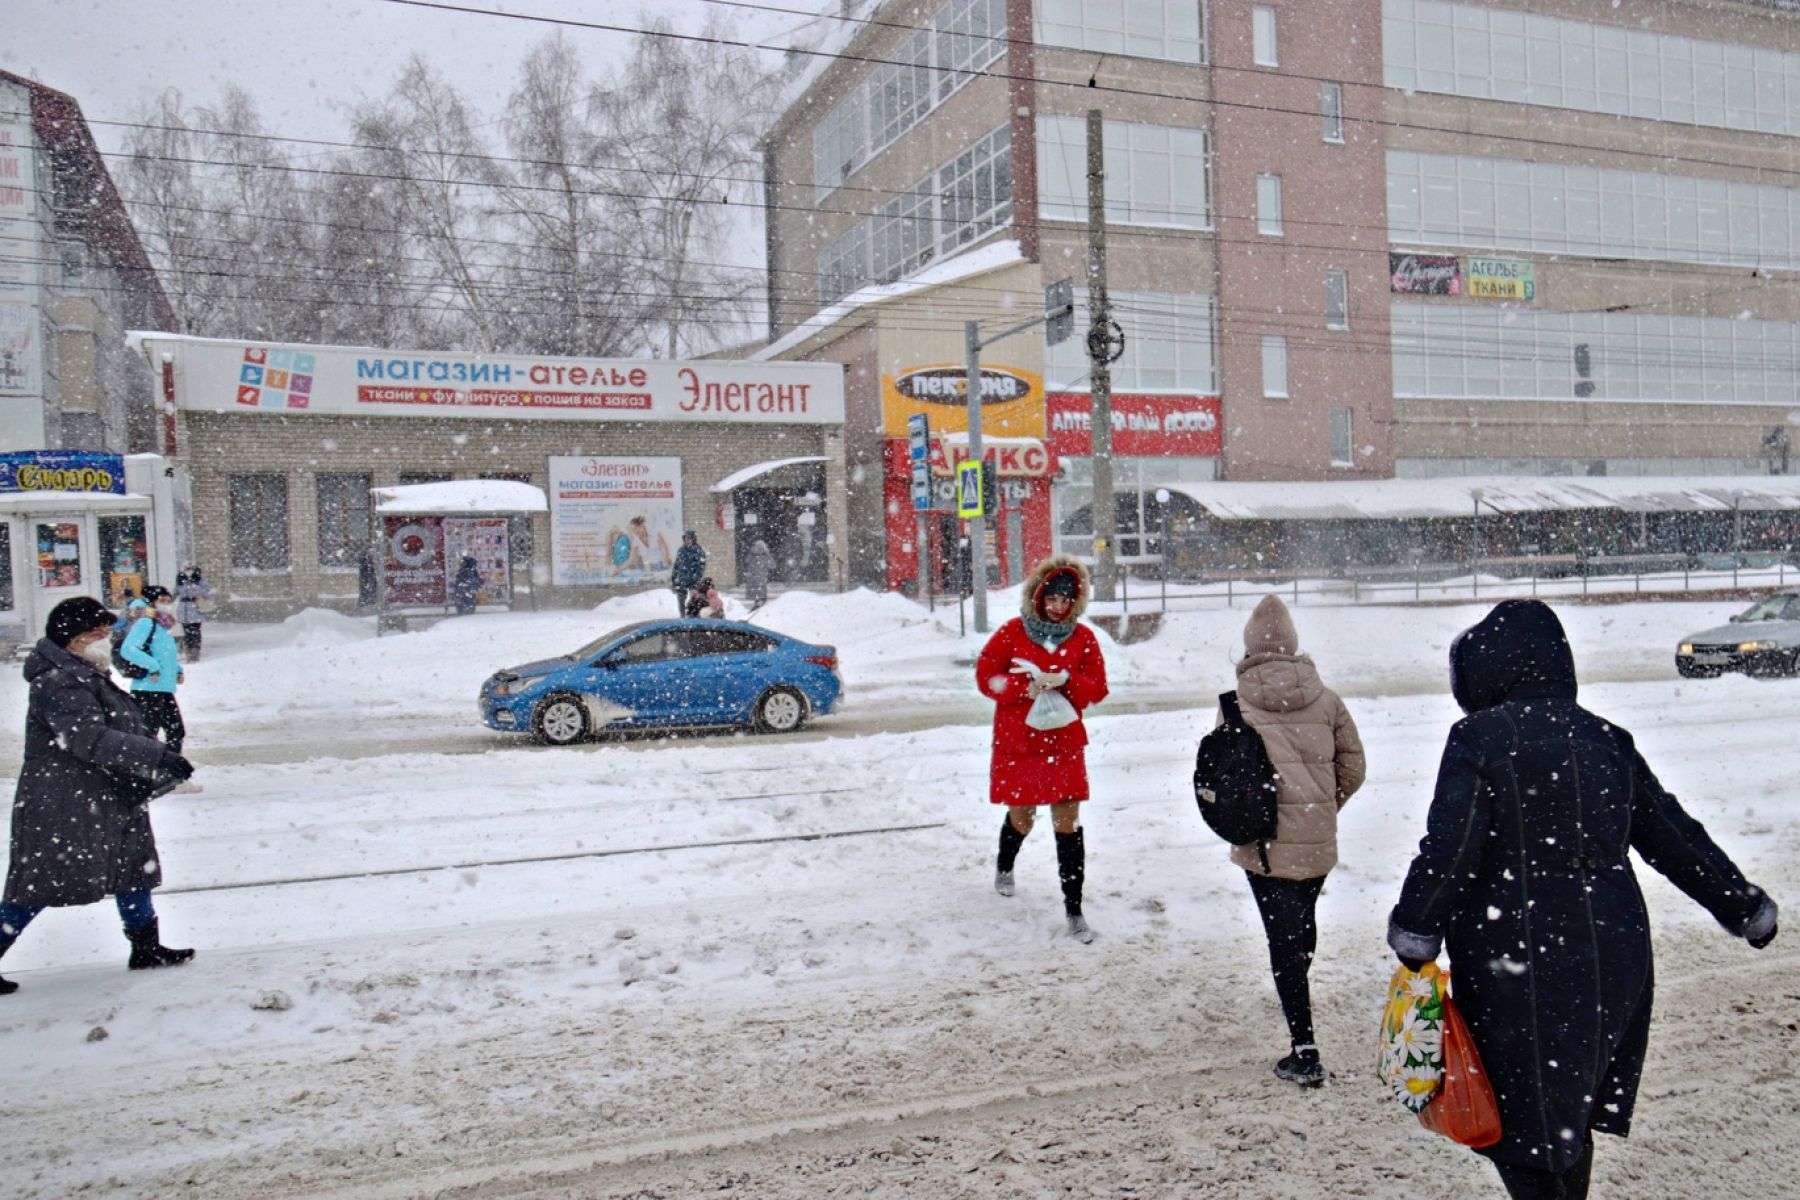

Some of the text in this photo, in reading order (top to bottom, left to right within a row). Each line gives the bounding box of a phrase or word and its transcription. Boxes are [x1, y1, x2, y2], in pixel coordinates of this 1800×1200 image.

[1473, 281, 1516, 296] ТКАНИ
[367, 389, 414, 400] ткани
[604, 396, 645, 407] заказ
[678, 367, 811, 414] Элегант
